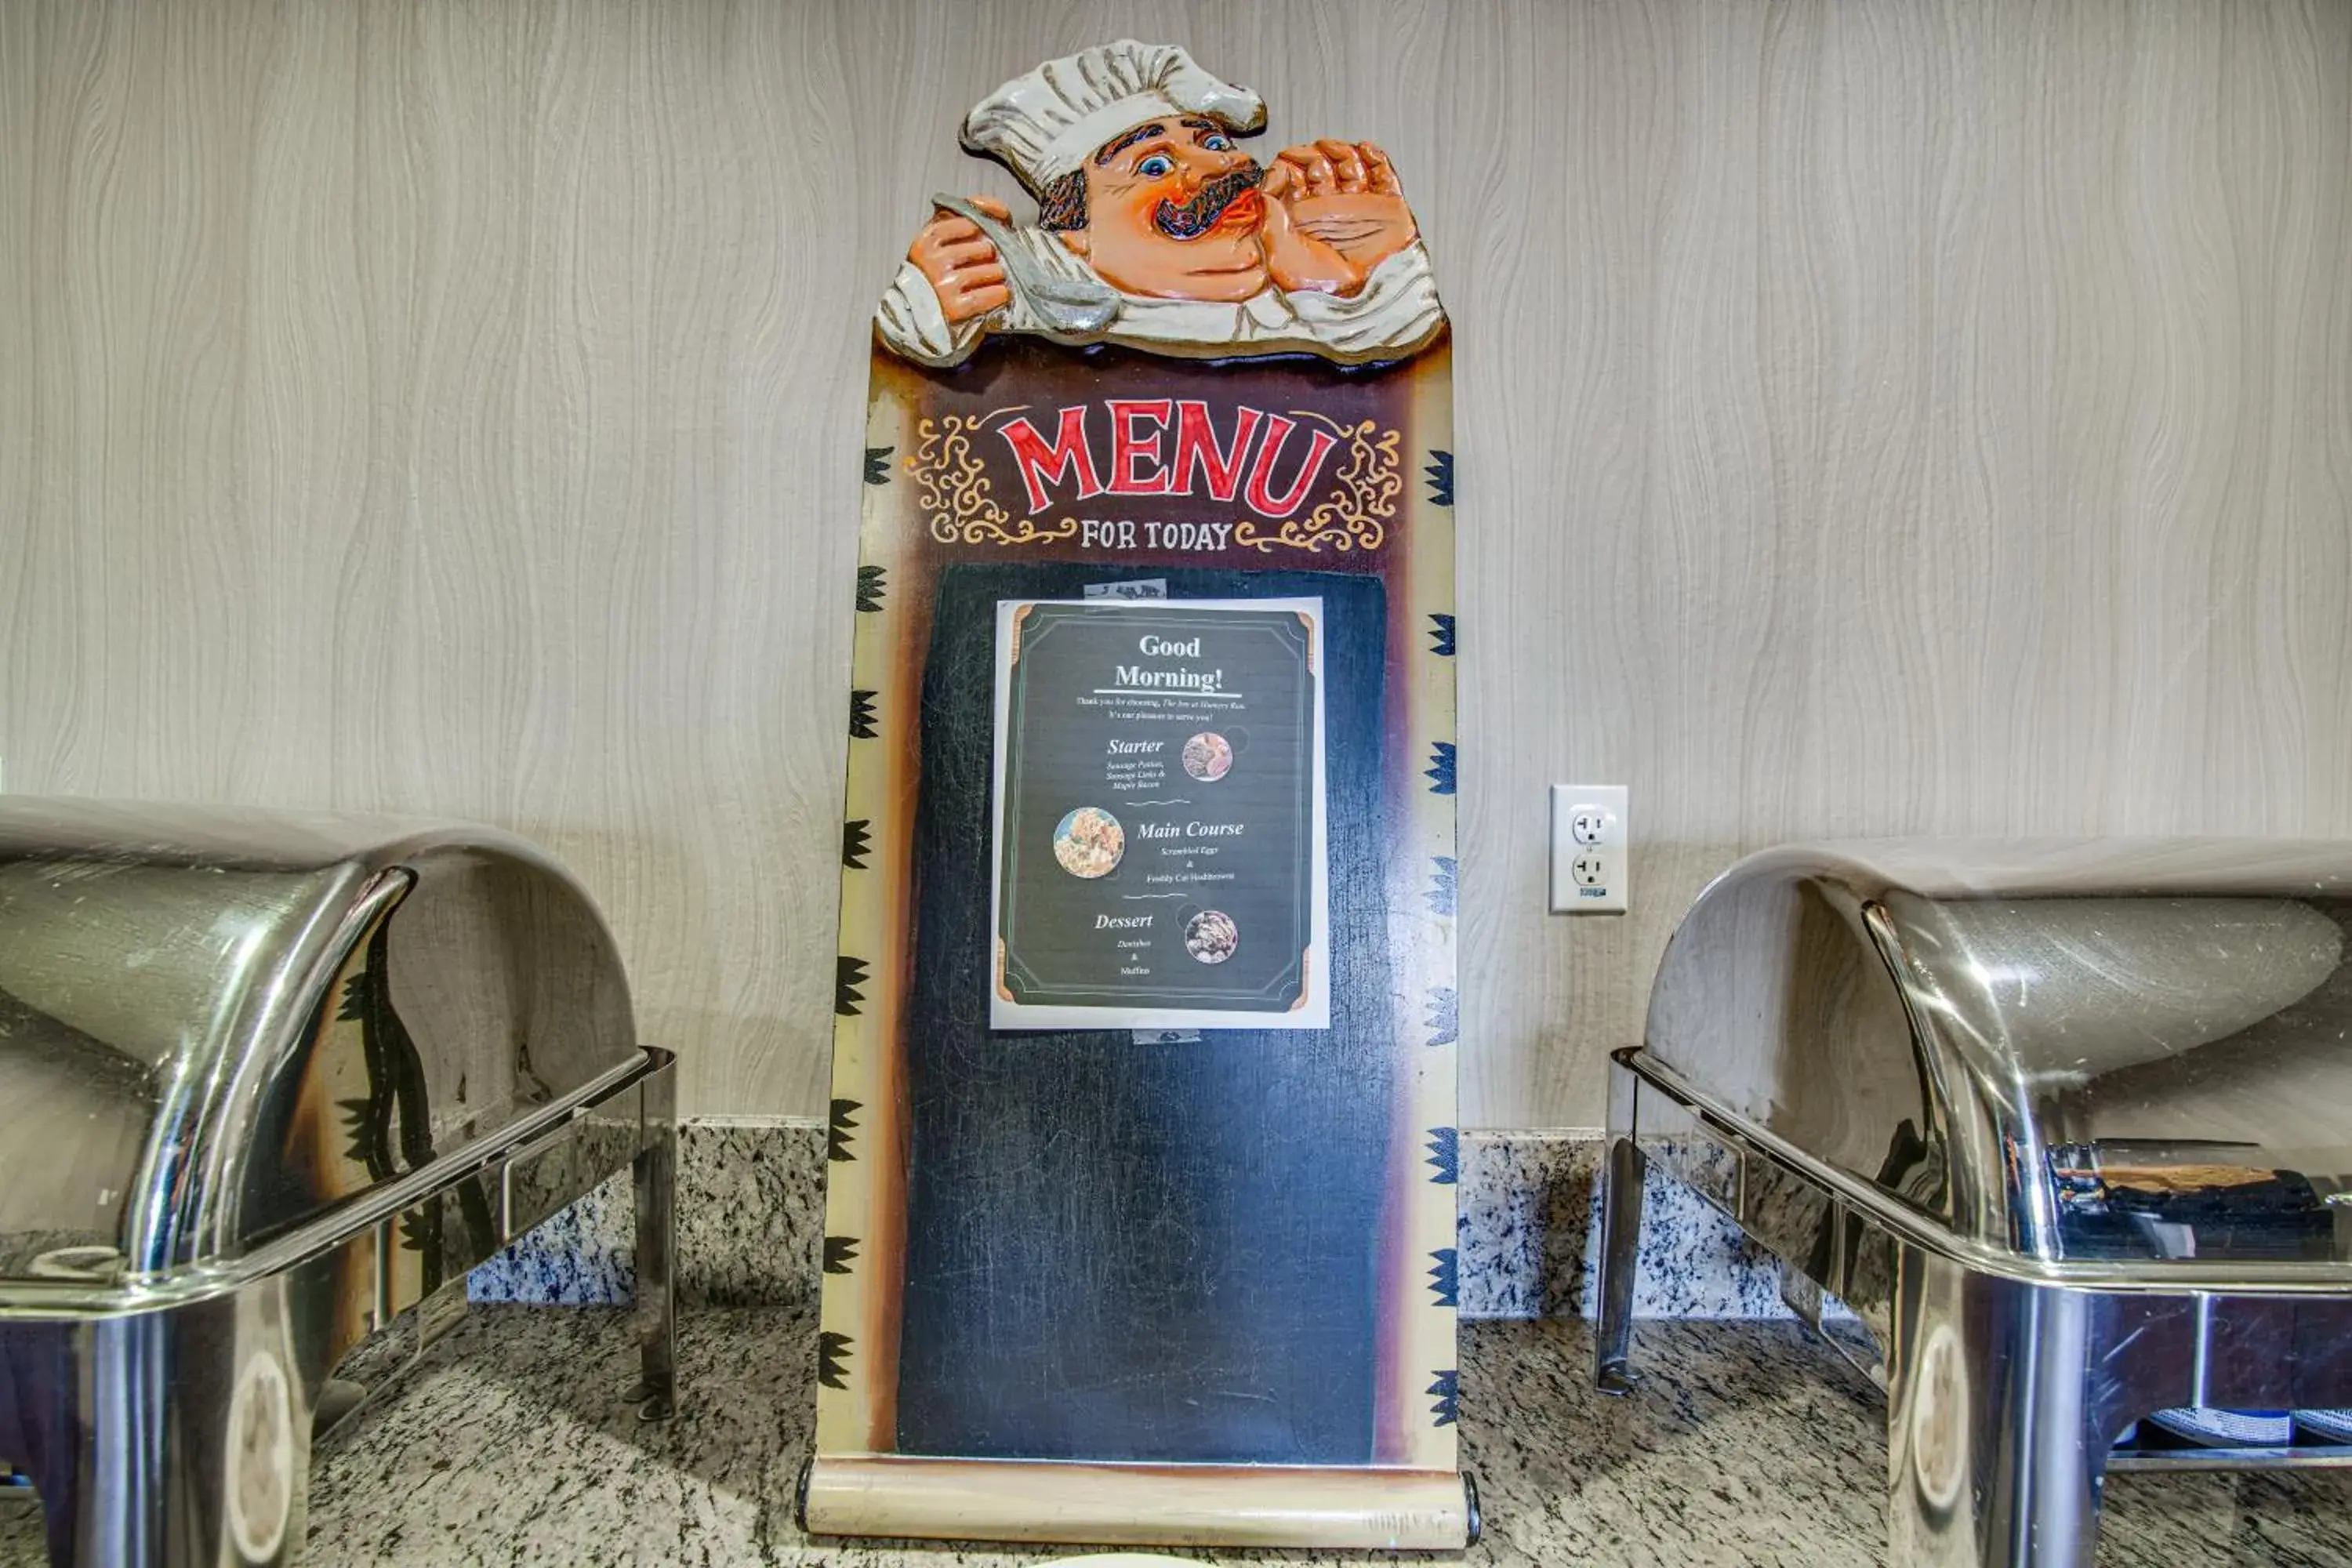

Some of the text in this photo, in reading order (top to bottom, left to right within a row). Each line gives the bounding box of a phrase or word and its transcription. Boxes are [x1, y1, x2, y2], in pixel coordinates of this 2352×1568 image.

[996, 398, 1338, 517] MENU
[1080, 519, 1233, 551] FOR TODAY
[1139, 634, 1201, 658] Good
[1115, 666, 1223, 693] Morning!
[1107, 739, 1165, 754] Starter
[1137, 821, 1244, 839] Main Course
[1094, 913, 1153, 929] Dessert
